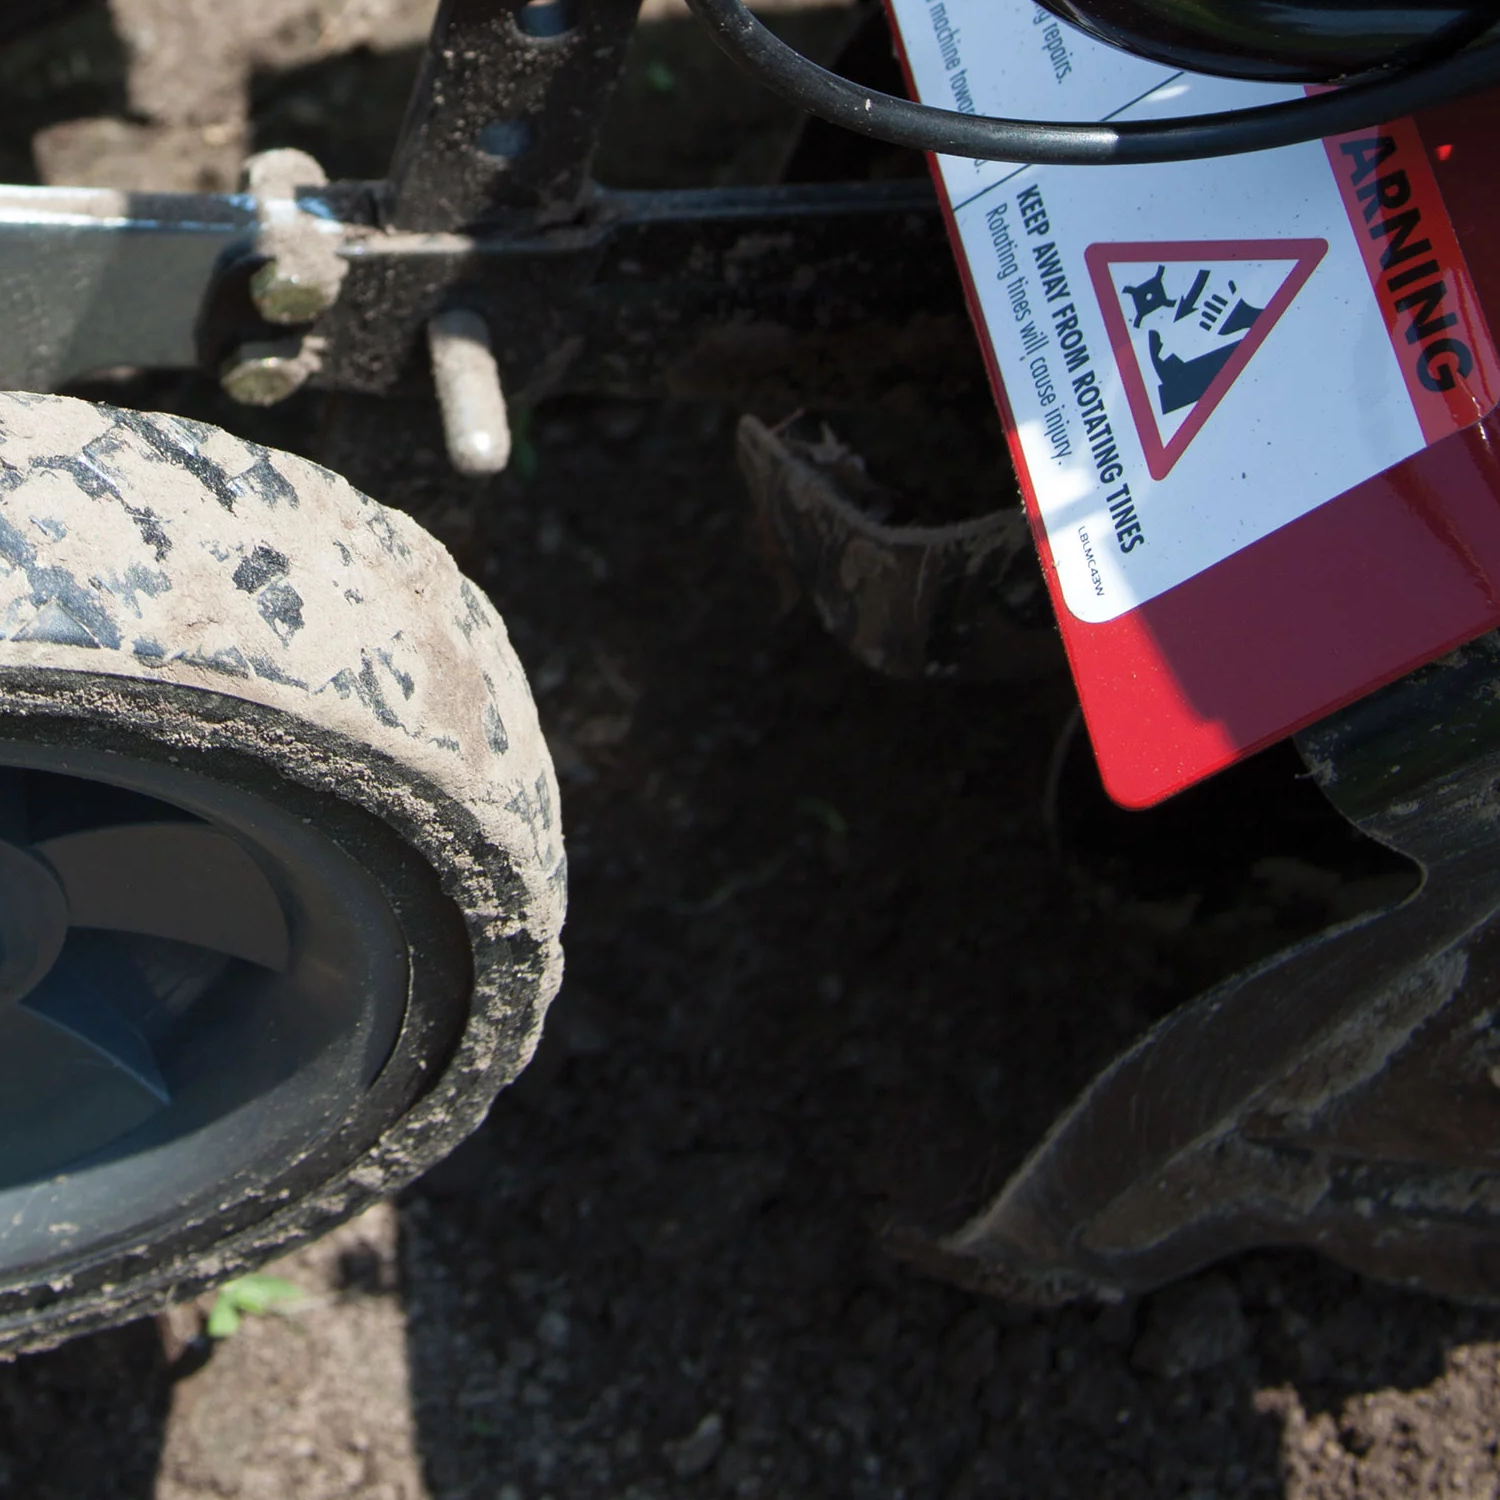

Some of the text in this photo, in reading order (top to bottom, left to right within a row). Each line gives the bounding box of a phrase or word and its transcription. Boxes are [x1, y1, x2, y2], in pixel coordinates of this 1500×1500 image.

[928, 1, 962, 72] machine
[1041, 21, 1074, 85] repairs.
[984, 201, 1072, 466] Rotating tines will cause injury.
[1339, 136, 1473, 392] ARNING
[1016, 183, 1145, 555] KEEP AWAY FROM ROTATING TINES
[1077, 525, 1106, 597] LBLMC43W
